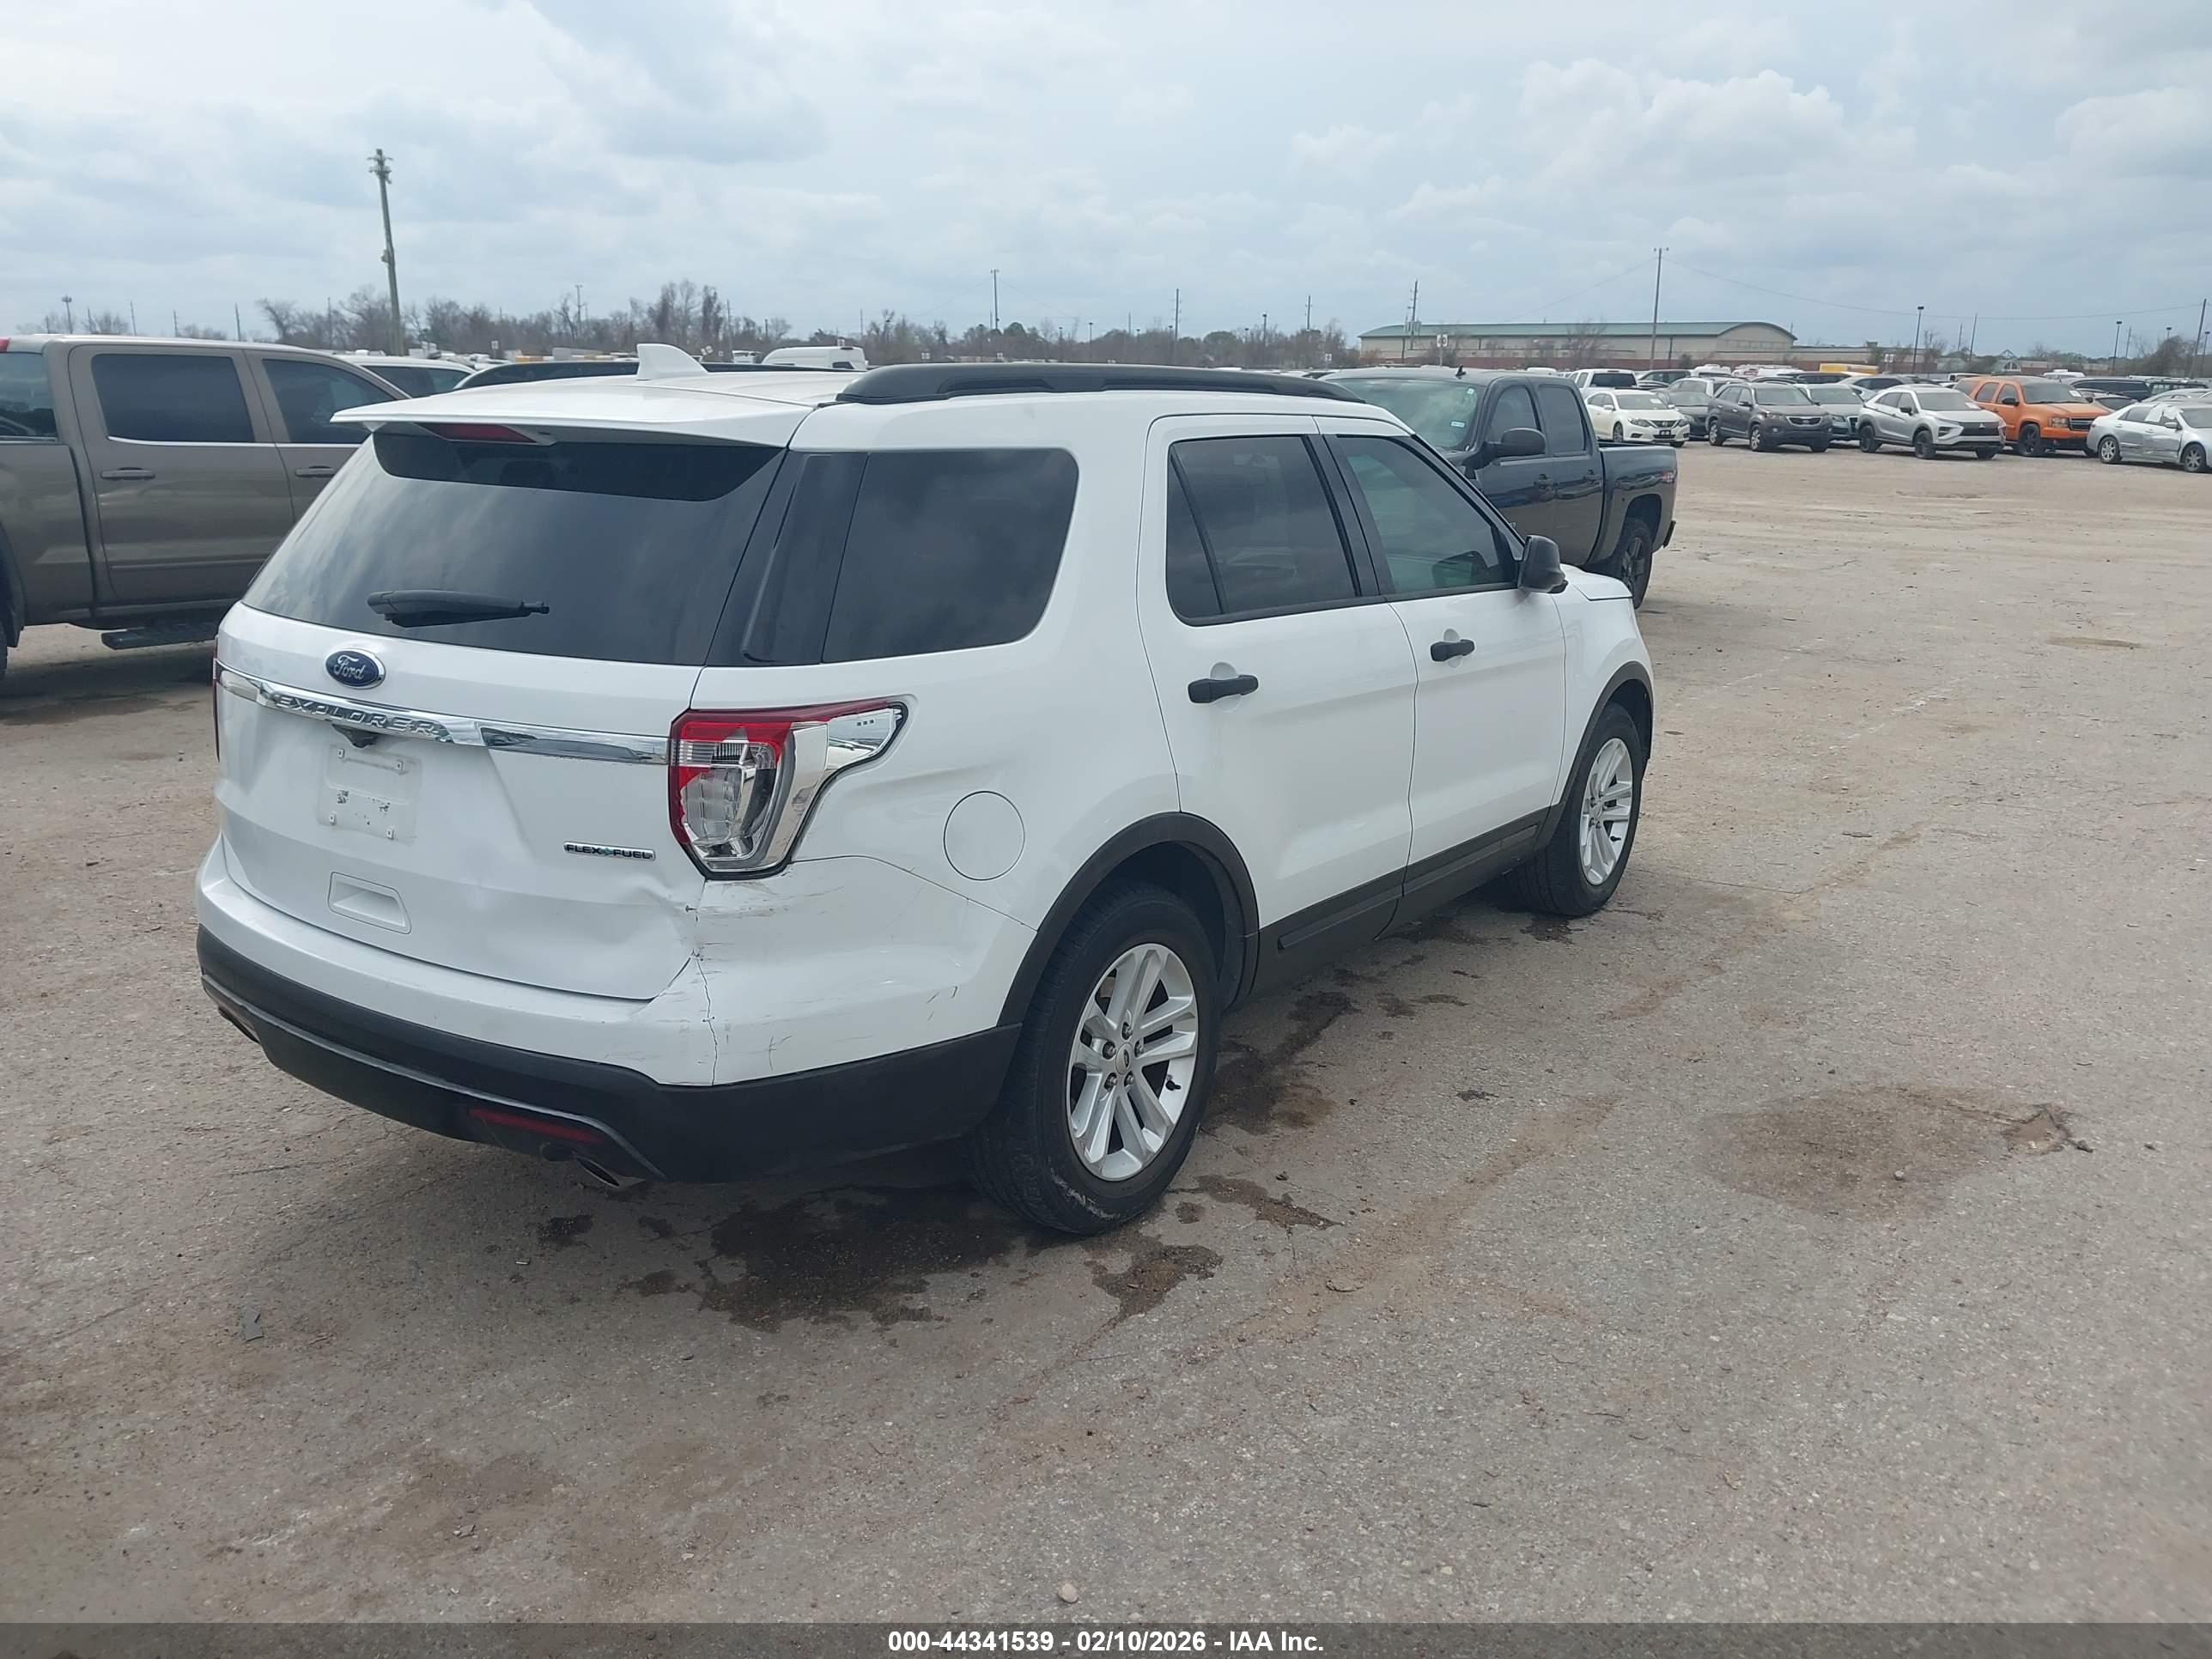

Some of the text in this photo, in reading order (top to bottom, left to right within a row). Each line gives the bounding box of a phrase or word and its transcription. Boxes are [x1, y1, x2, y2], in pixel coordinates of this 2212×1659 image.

[334, 654, 366, 680] Ford
[276, 694, 439, 736] EXPLORER
[566, 844, 653, 860] FLEX FUEL
